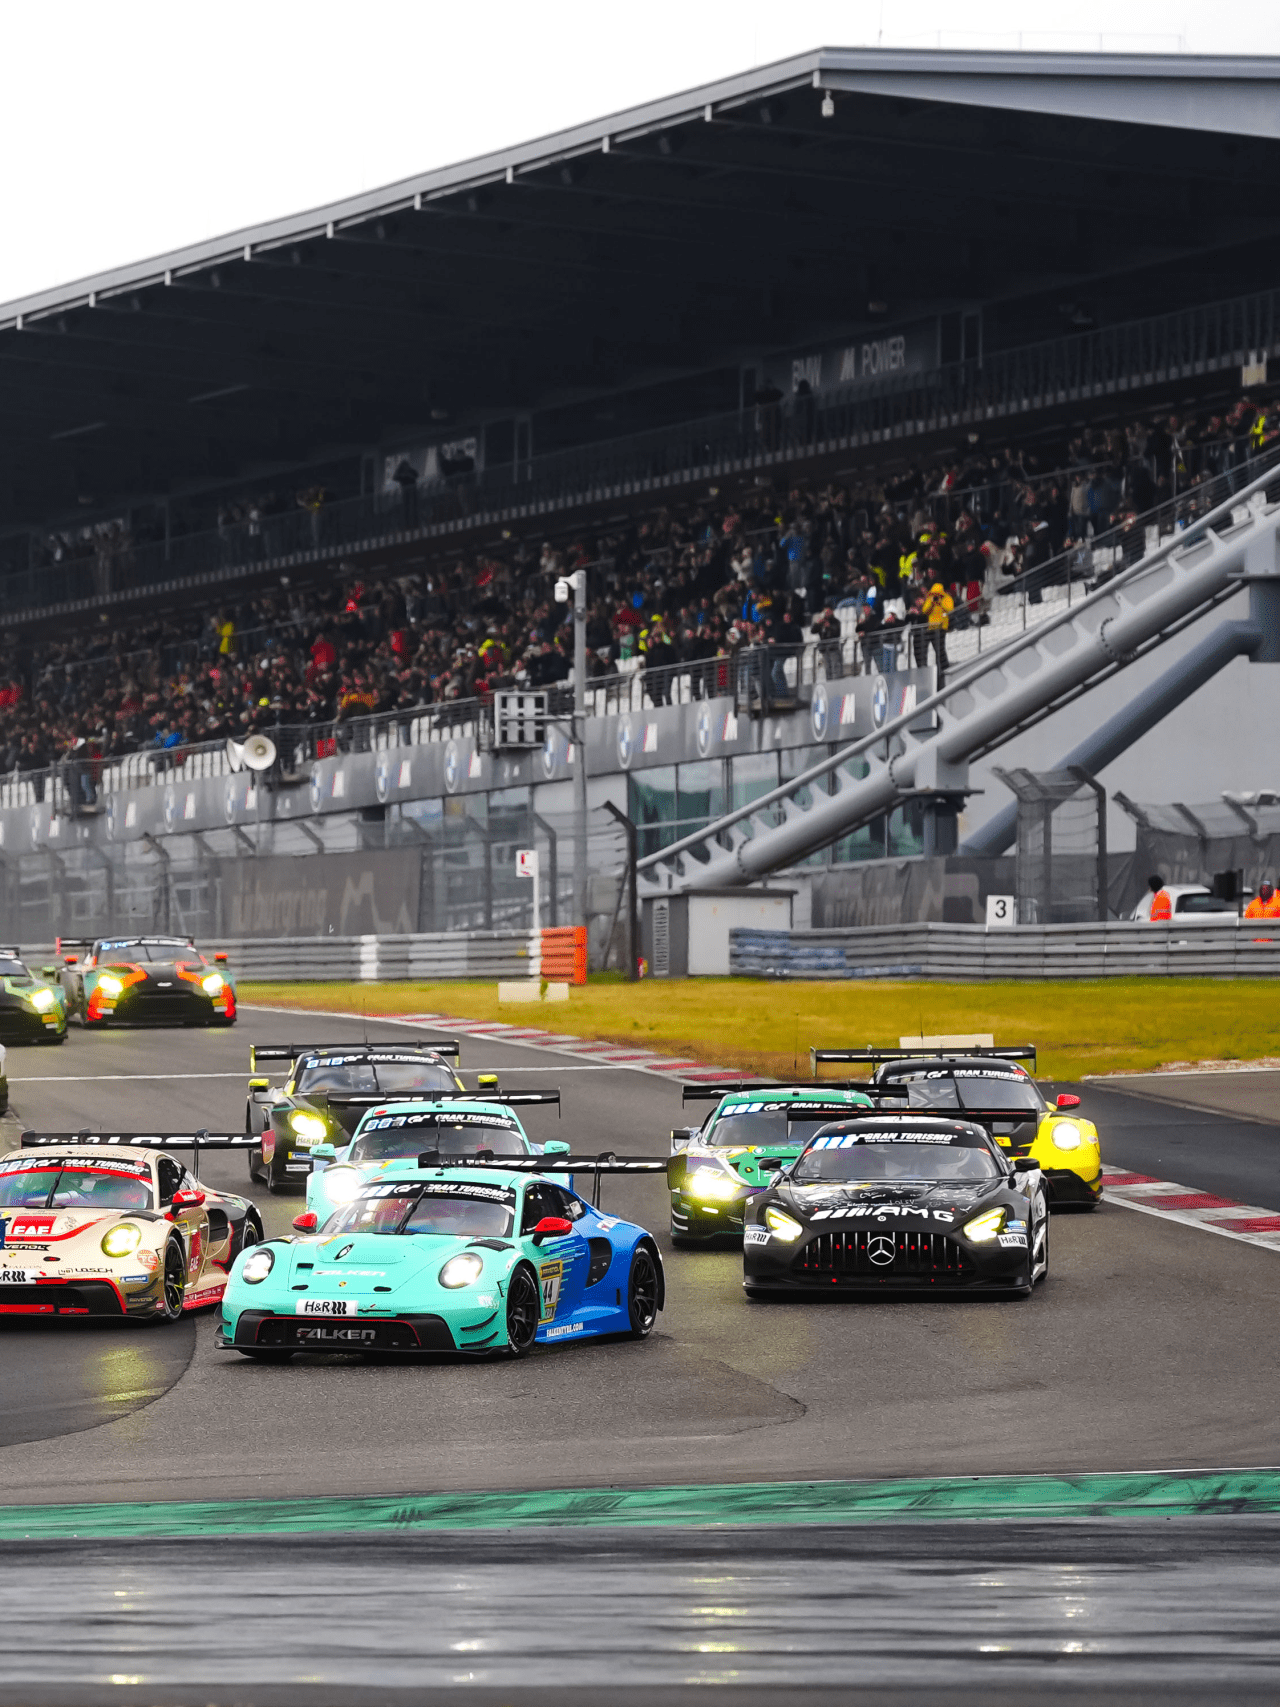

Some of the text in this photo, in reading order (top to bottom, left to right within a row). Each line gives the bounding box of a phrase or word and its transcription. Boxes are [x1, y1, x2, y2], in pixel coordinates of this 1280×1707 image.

[861, 335, 905, 376] POWER
[995, 900, 1007, 918] 3
[953, 1069, 981, 1077] GRAN
[981, 1070, 1026, 1082] TURISMO
[435, 1114, 467, 1122] GRAN
[469, 1114, 515, 1126] TURISMO
[864, 1132, 953, 1143] GRAN TURISMO
[62, 1159, 94, 1168] GRAN
[95, 1160, 146, 1173] TURISMO
[427, 1183, 457, 1192] GRAN
[458, 1184, 512, 1199] TURISMO
[872, 1206, 955, 1223] AMG
[543, 1280, 554, 1305] 44
[297, 1327, 376, 1340] FALKEN
